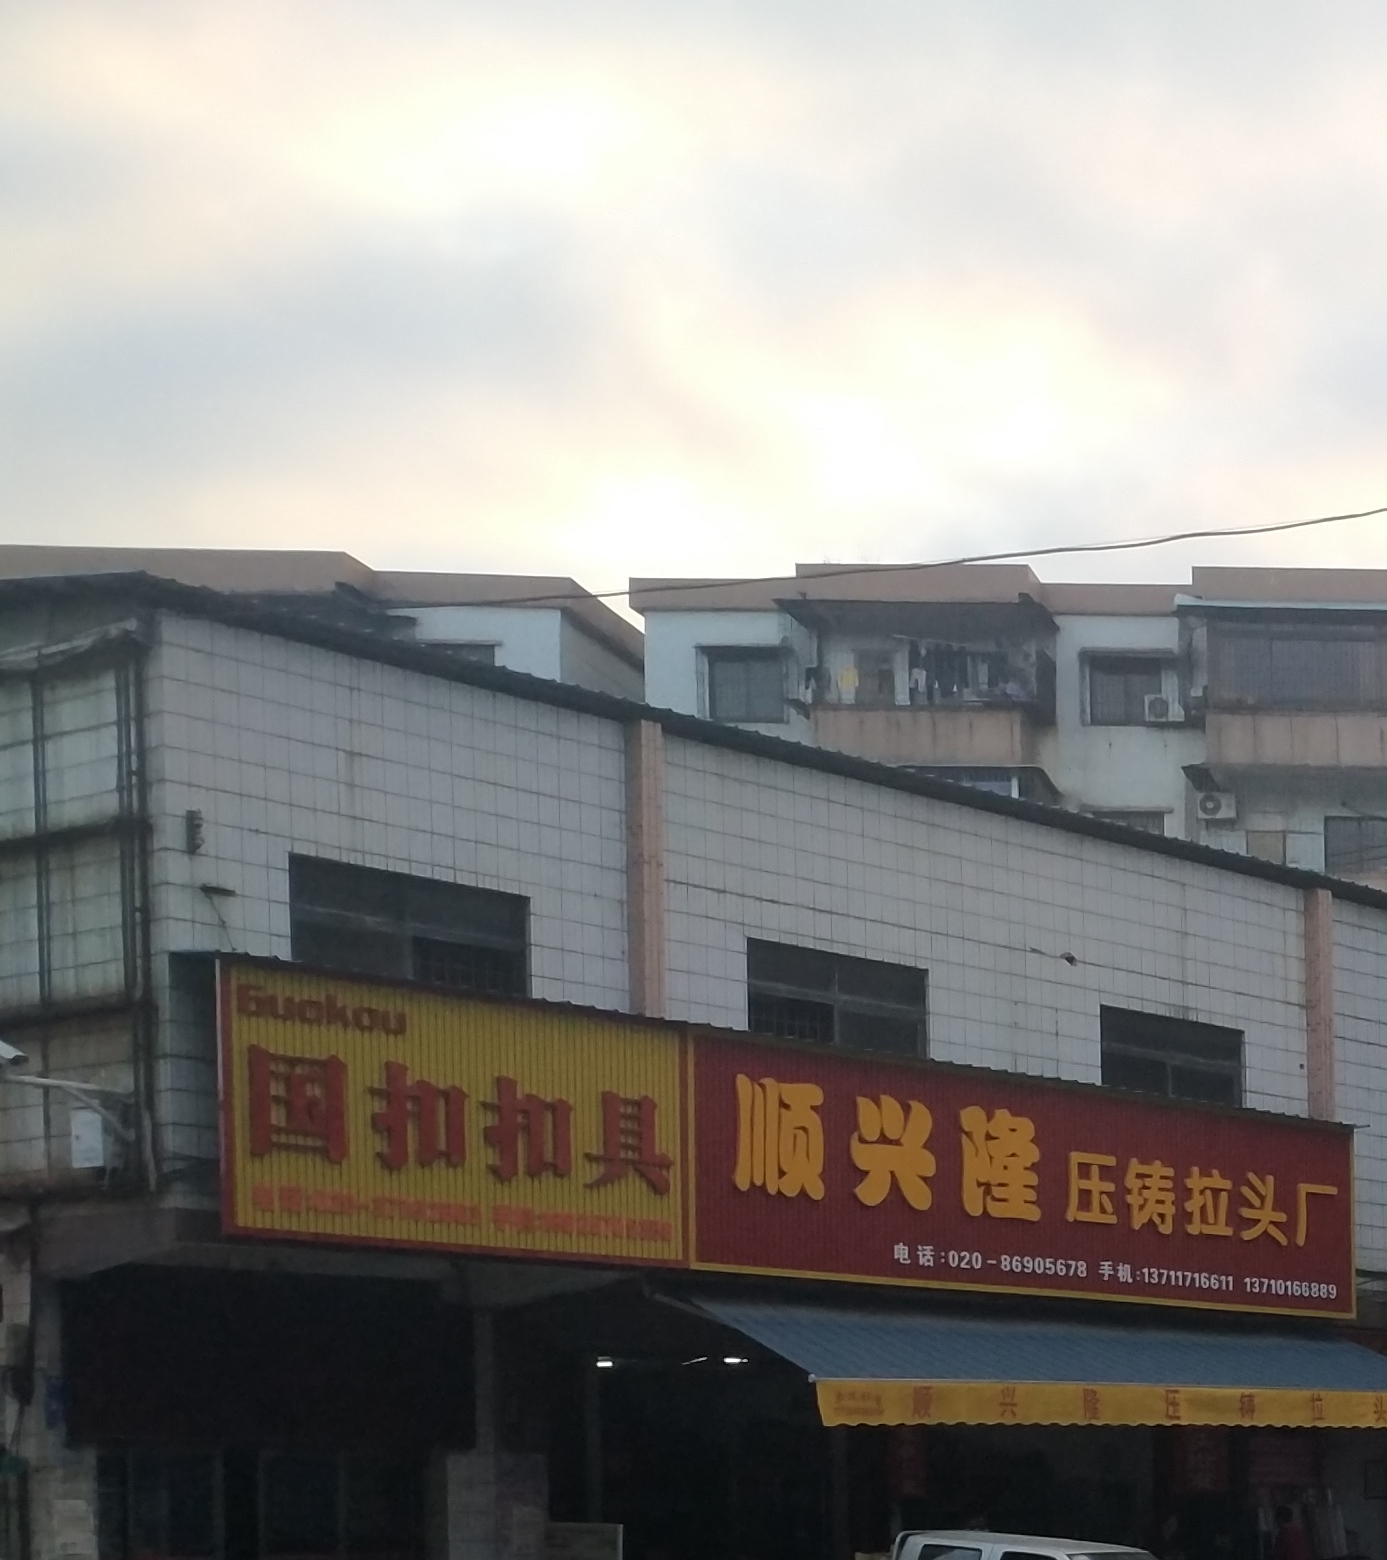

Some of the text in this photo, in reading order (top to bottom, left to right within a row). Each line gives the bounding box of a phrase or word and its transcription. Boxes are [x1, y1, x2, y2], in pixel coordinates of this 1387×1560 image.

[237, 984, 408, 1036] Guokou
[248, 1043, 675, 1196] 国扣扣具
[733, 1073, 1339, 1247] 顺兴隆 压铸拉头厂
[1243, 1276, 1338, 1301] 13710166889
